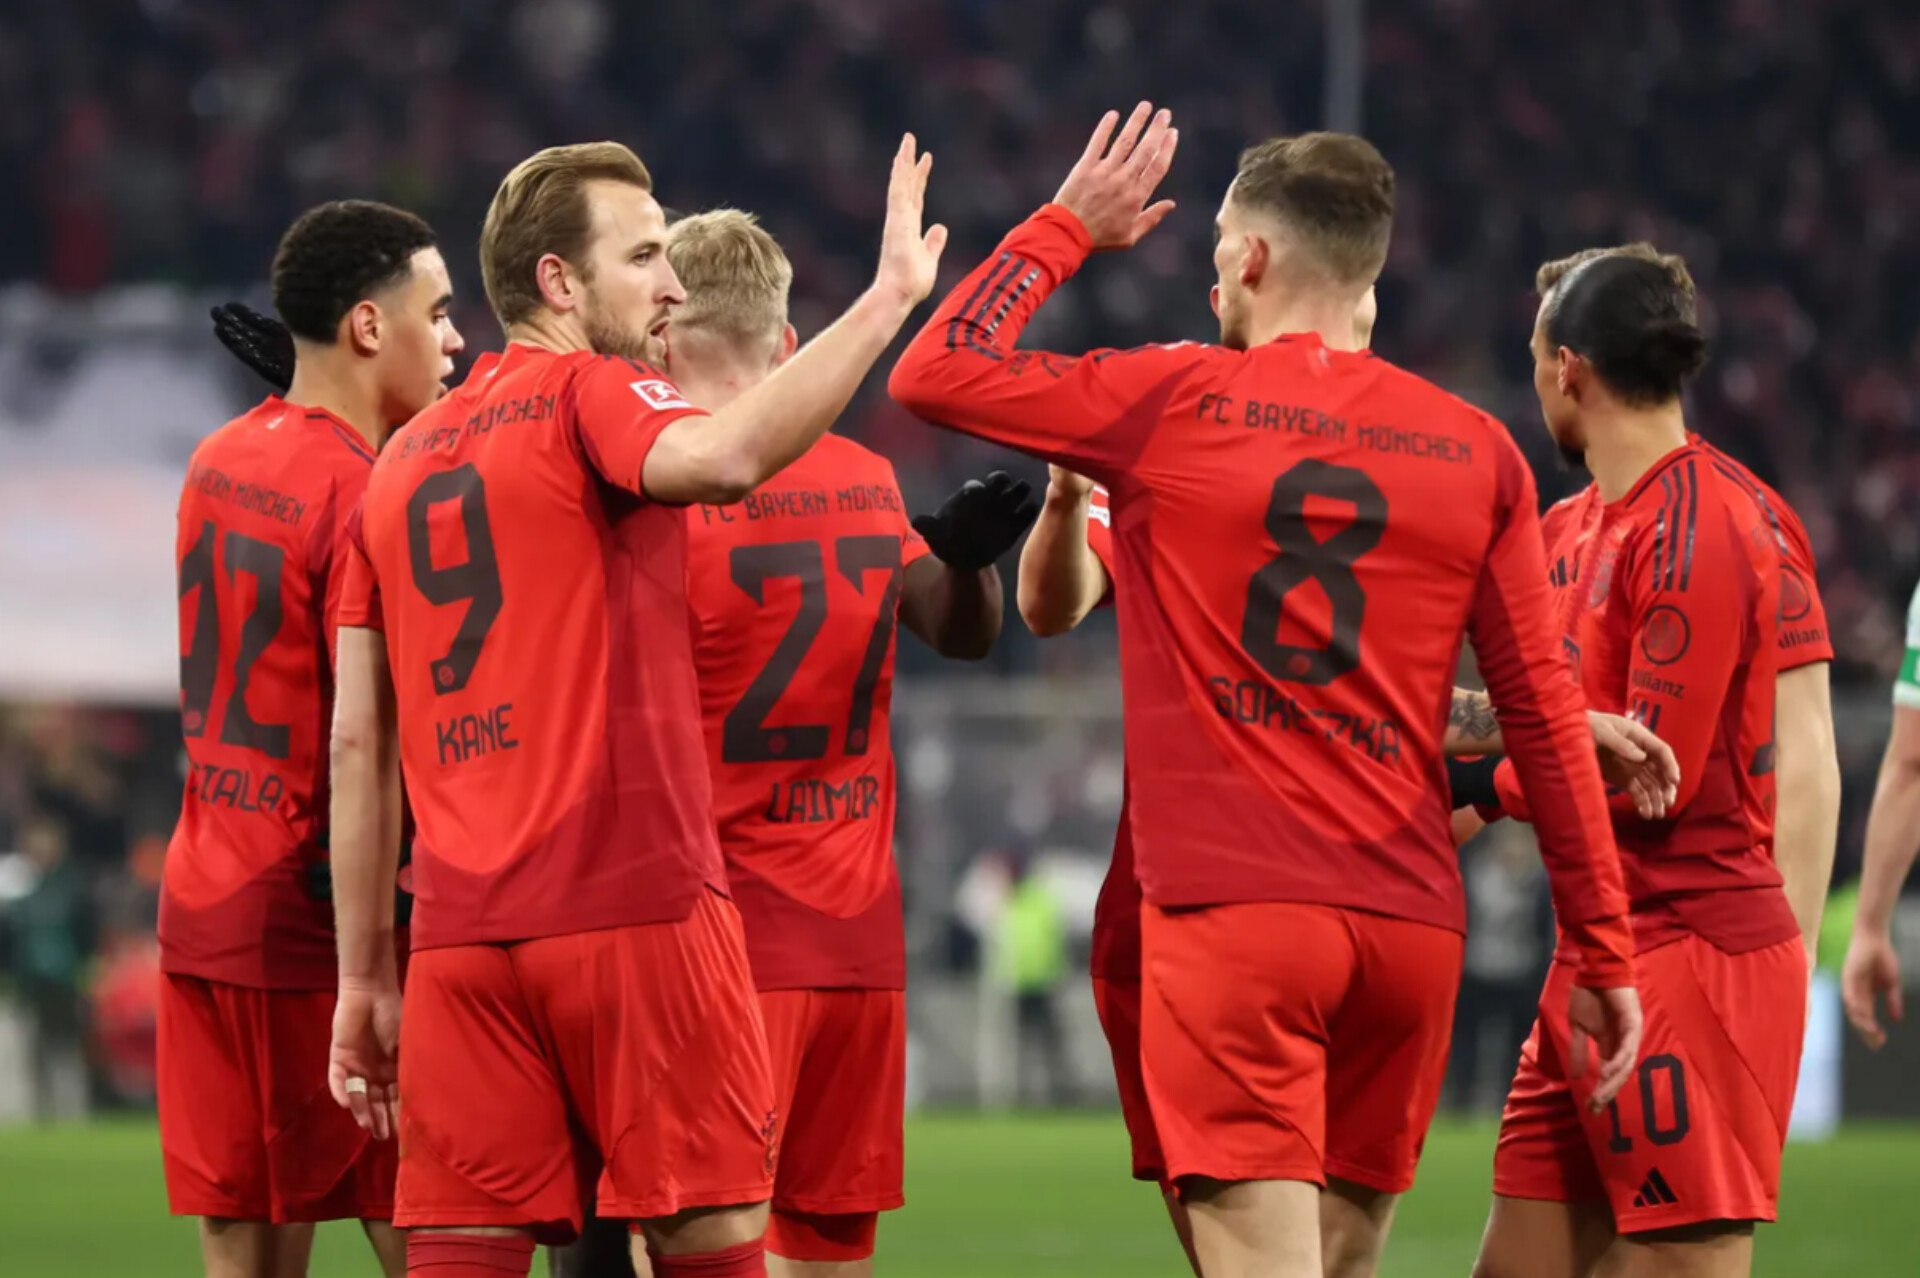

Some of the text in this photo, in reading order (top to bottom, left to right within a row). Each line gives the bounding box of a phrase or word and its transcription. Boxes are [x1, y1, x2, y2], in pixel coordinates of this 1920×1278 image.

[1196, 392, 1473, 465] FC BAYERN MÜNCHEN
[743, 488, 829, 520] BAYERN
[406, 462, 505, 696] 9
[1240, 457, 1388, 686] 8
[721, 533, 903, 764] 27
[436, 704, 519, 765] KANE
[1607, 1053, 1691, 1154] 10
